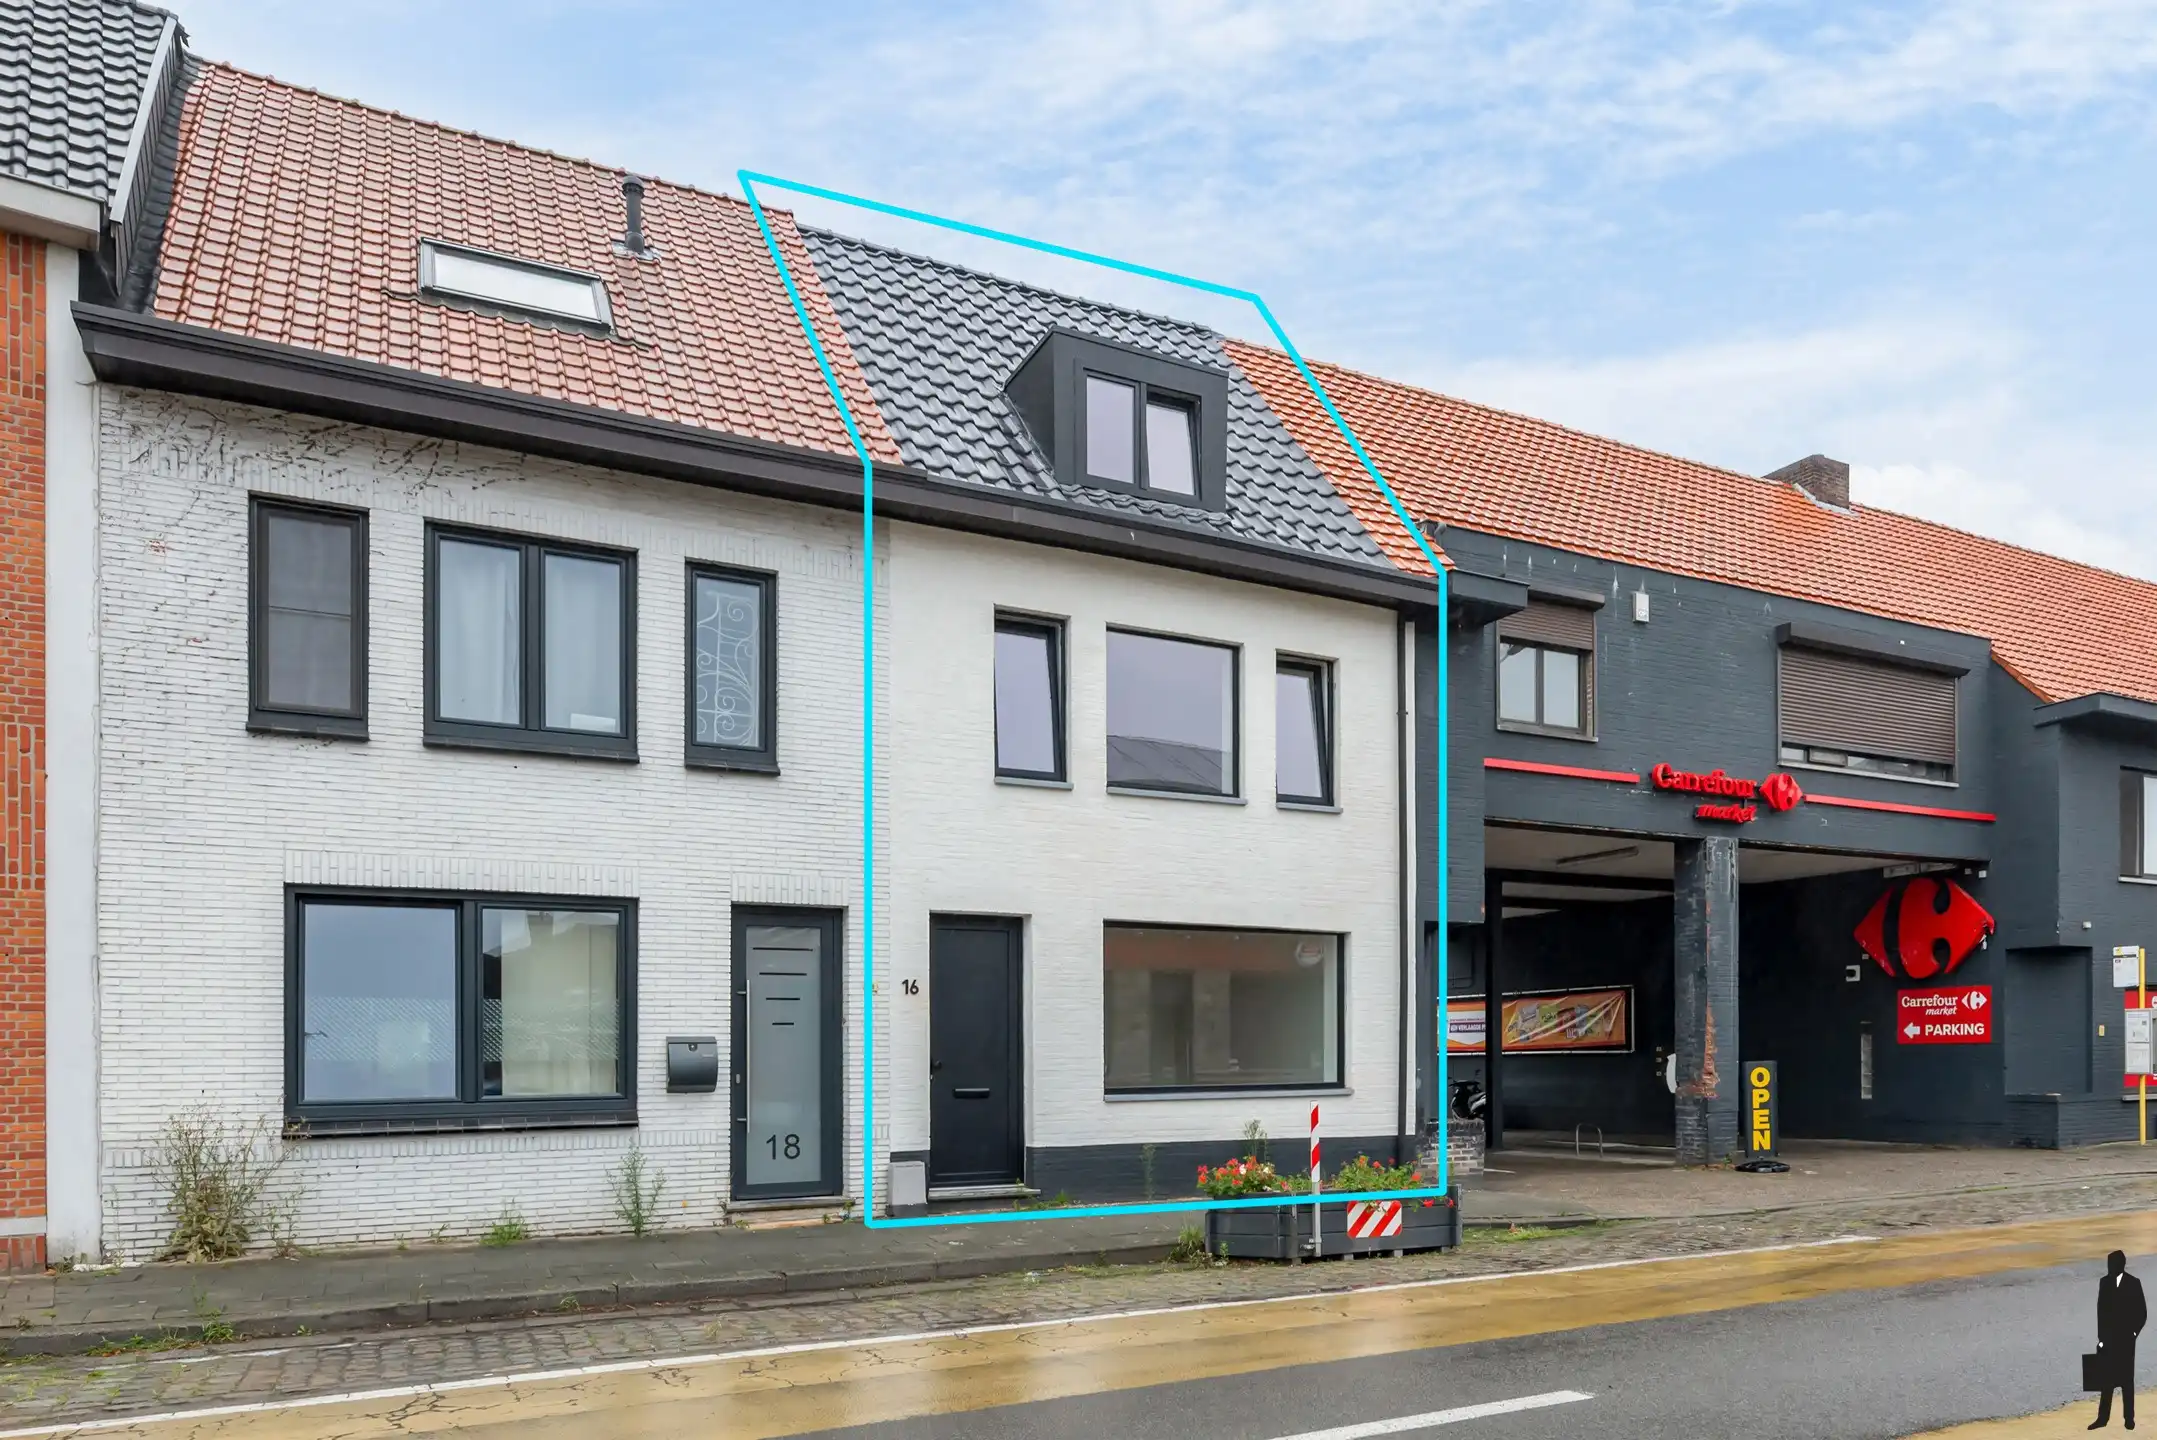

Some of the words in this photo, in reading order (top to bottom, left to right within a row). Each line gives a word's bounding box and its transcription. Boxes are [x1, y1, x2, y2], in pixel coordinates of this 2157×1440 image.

[1651, 762, 1757, 798] Carrefour
[1696, 804, 1757, 824] market
[901, 978, 920, 996] 16
[1901, 994, 1958, 1008] Carrefour
[1925, 1006, 1957, 1016] market
[1925, 1023, 1985, 1036] PARKING
[1750, 1066, 1771, 1151] OPEN
[766, 1133, 801, 1160] 18
